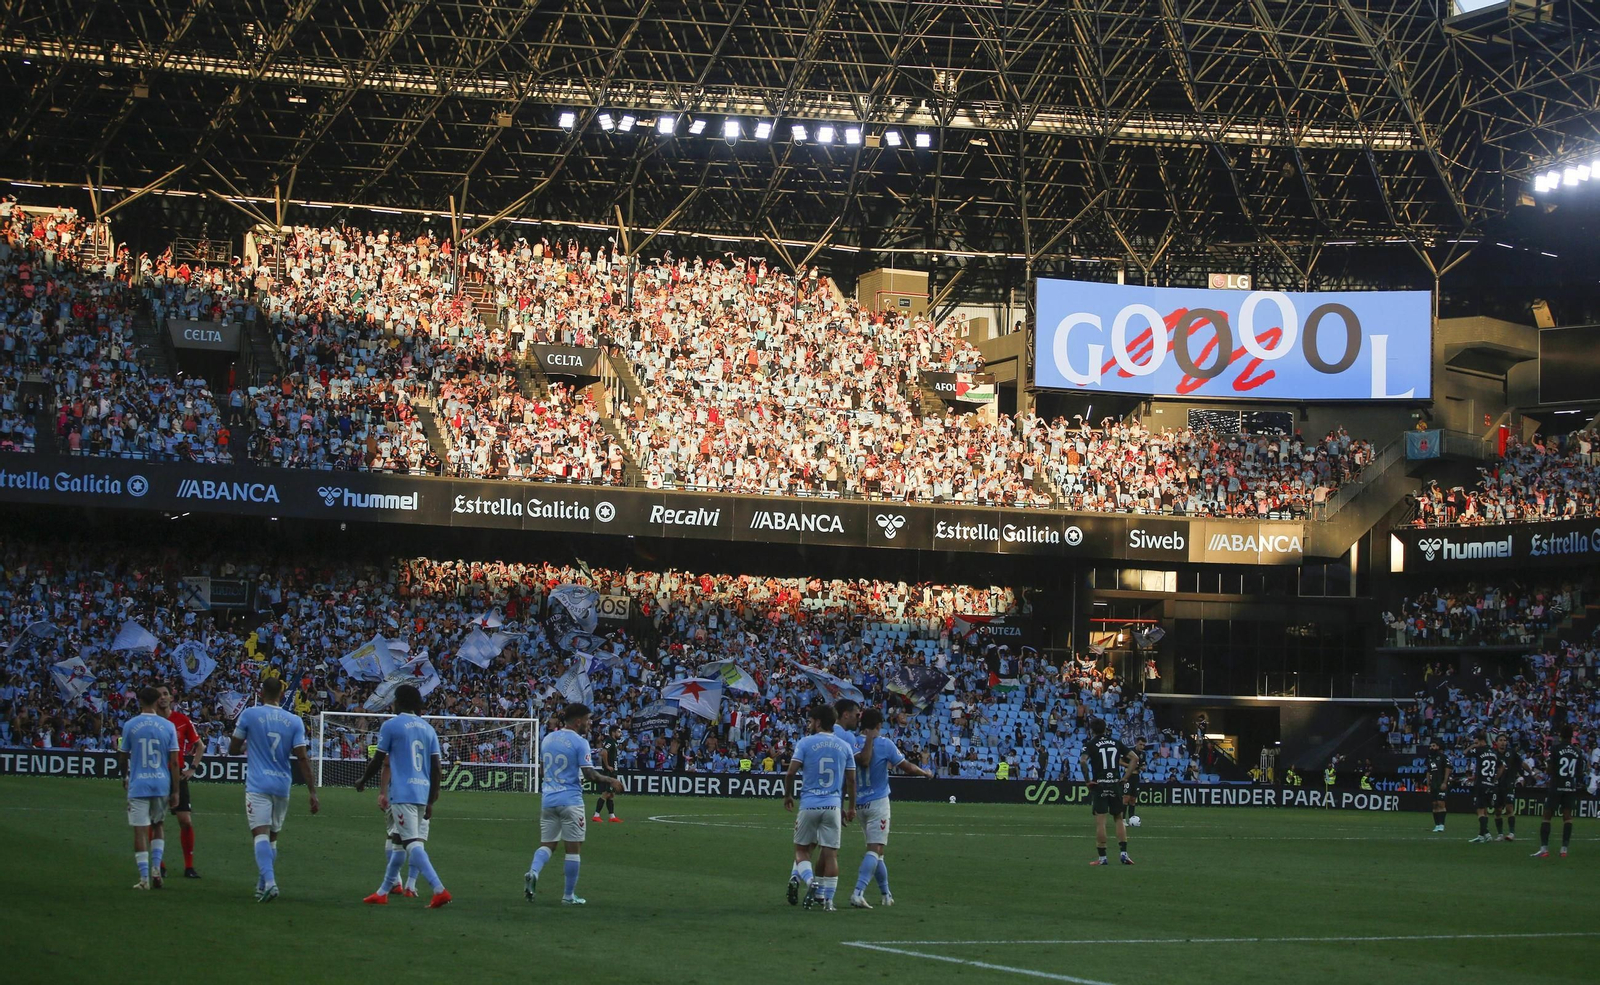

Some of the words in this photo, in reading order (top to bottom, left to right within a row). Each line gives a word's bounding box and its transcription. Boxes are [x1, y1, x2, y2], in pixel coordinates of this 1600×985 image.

[1227, 274, 1249, 289] LG
[184, 328, 222, 342] CELTA
[1053, 291, 1415, 399] GOOOOL
[547, 353, 583, 367] CELTA
[54, 472, 122, 494] Galicia
[343, 488, 418, 511] hummel
[453, 494, 523, 516] Estrella
[526, 498, 590, 520] Galicia
[650, 504, 720, 526] Recalvi
[935, 521, 999, 541] Estrella
[1002, 523, 1060, 545] Galicia
[1129, 529, 1184, 550] Siweb
[1529, 531, 1588, 556] Estrella
[1443, 535, 1513, 560] hummel
[138, 737, 161, 769] 15
[267, 731, 281, 762] 7
[411, 740, 424, 772] 6
[0, 753, 96, 775] TENDER
[543, 752, 568, 784] 22
[1099, 747, 1118, 770] 17
[1481, 760, 1496, 777] 23
[1559, 757, 1577, 778] 24
[480, 771, 508, 788] JP
[818, 757, 835, 788] 5
[616, 774, 722, 795] NTENDER
[728, 777, 786, 796] PARA
[1065, 786, 1090, 802] JP
[1172, 787, 1276, 805] ENTENDER
[1282, 789, 1336, 808] PARA
[1341, 792, 1400, 811] PODER
